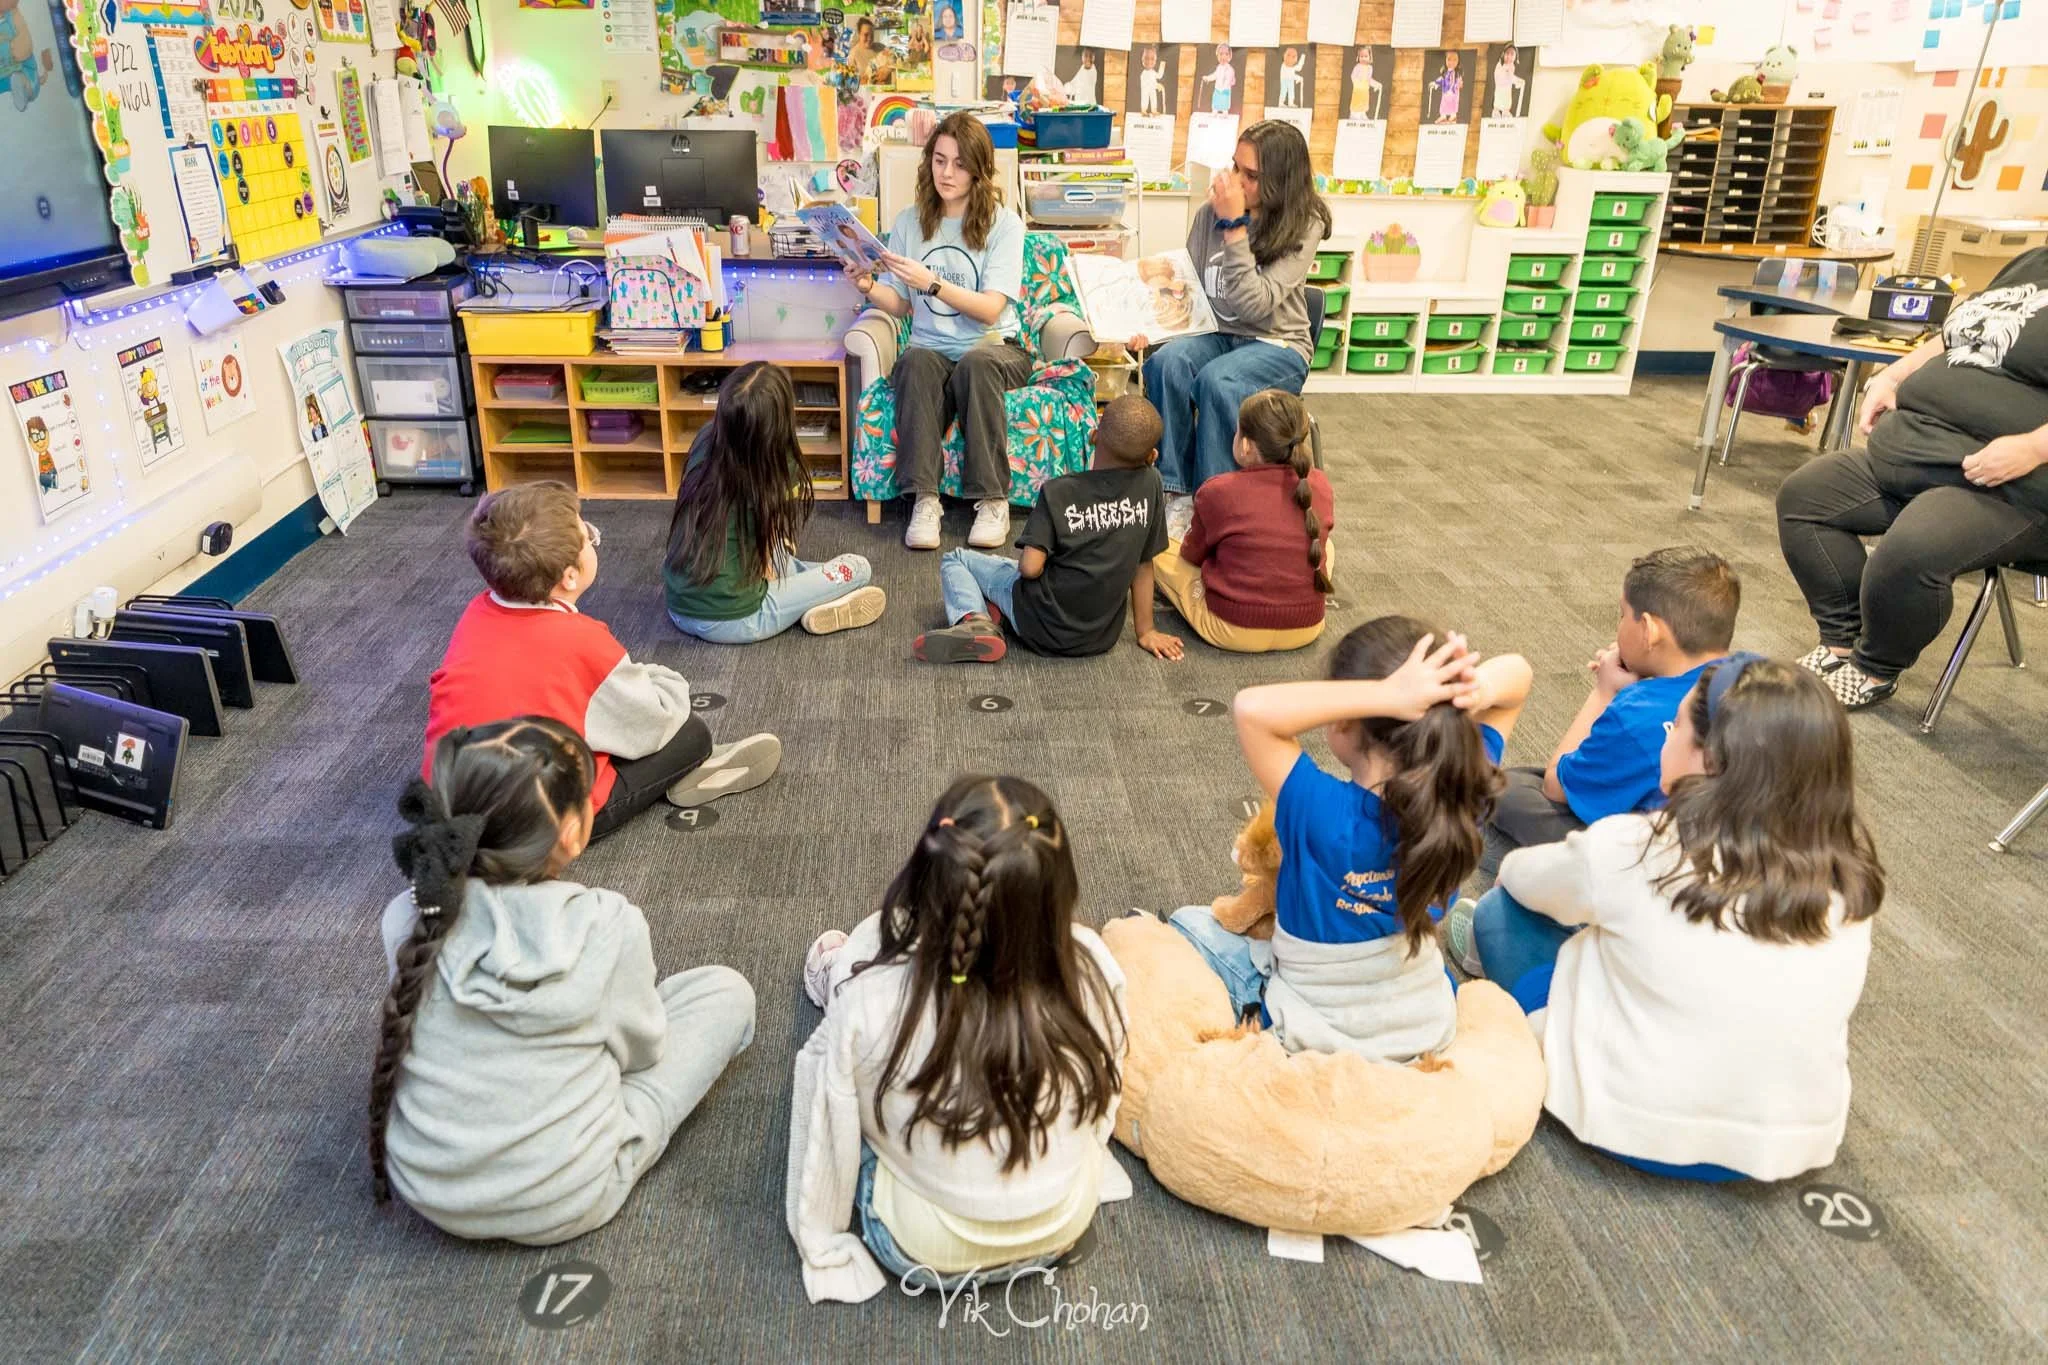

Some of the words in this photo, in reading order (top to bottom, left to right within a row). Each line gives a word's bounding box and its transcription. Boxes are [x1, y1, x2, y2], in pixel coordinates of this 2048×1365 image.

[722, 33, 749, 48] MRS
[210, 32, 275, 73] February
[937, 271, 966, 282] EADERS
[26, 379, 47, 397] THE
[1064, 497, 1149, 533] SHEESH
[692, 696, 711, 708] 5
[981, 697, 999, 710] 6
[1194, 701, 1212, 714] 7
[678, 809, 700, 826] 9
[1803, 1191, 1872, 1228] 20
[535, 1273, 593, 1315] 17
